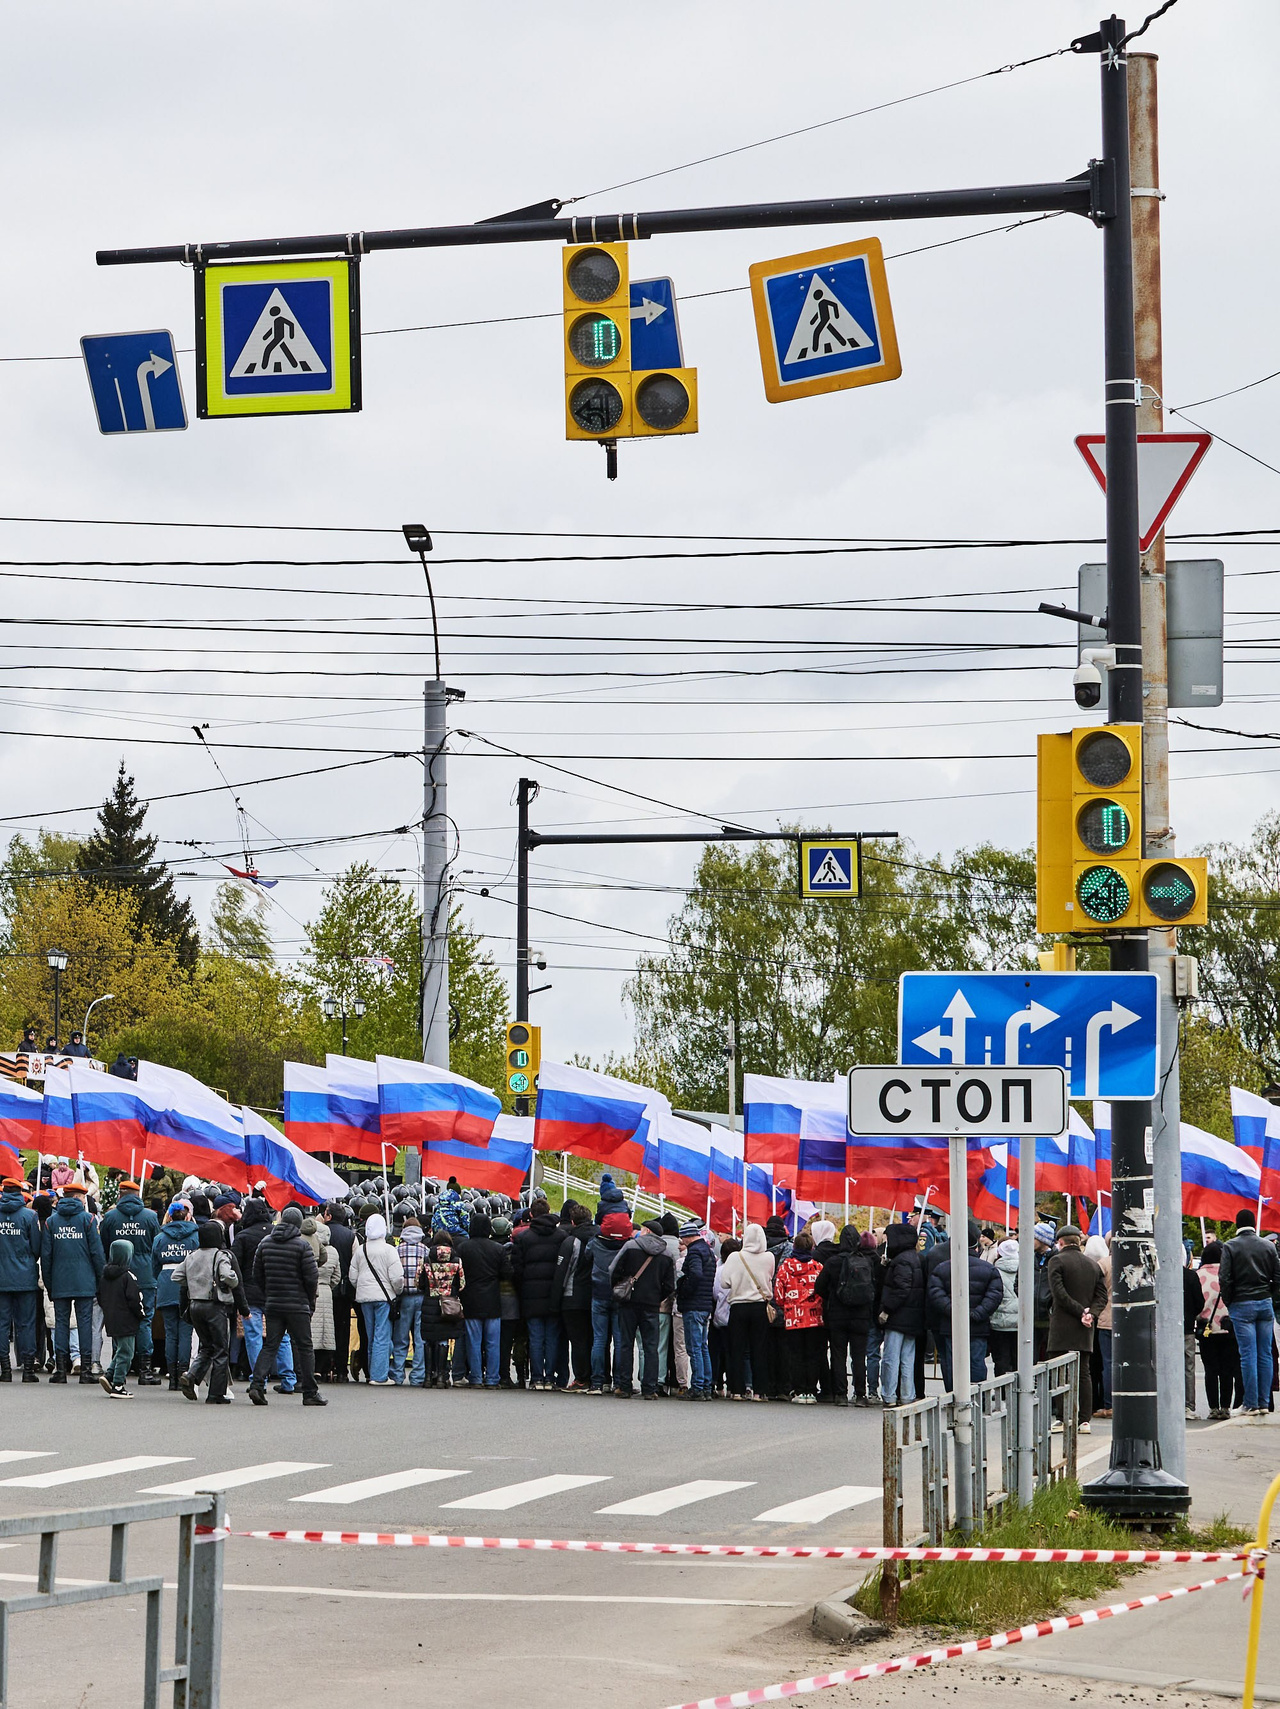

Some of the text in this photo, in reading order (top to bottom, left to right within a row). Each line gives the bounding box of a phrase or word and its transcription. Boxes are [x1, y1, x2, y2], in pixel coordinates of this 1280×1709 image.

[593, 319, 616, 360] 10
[1102, 805, 1126, 847] 10
[517, 1051, 527, 1067] 10
[878, 1078, 1033, 1124] СТОП
